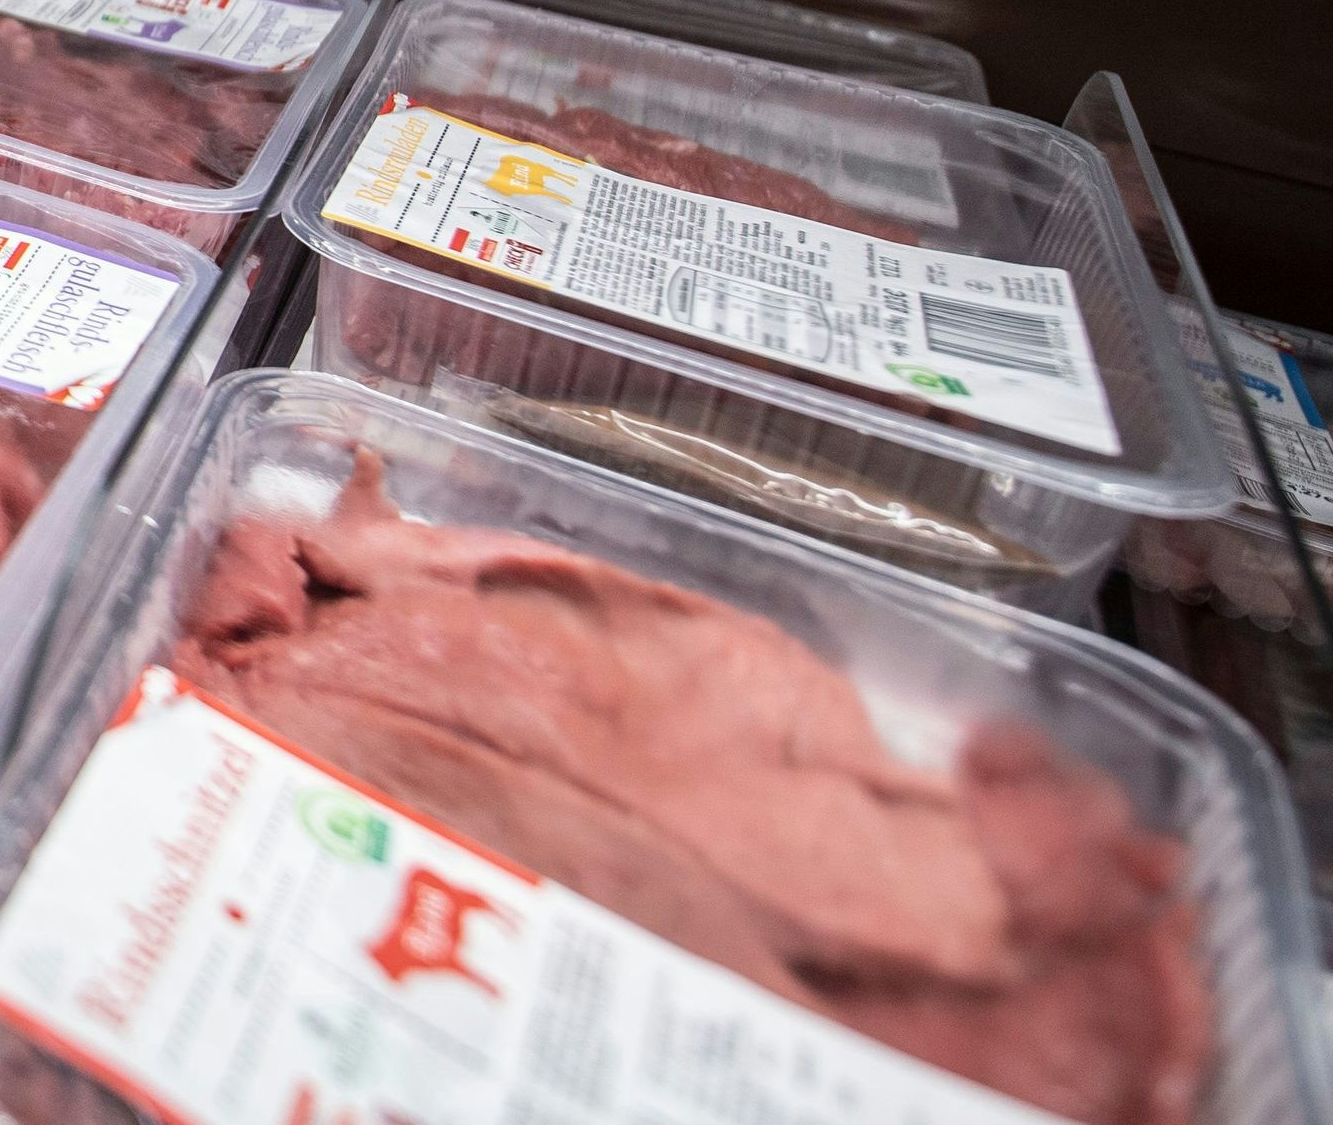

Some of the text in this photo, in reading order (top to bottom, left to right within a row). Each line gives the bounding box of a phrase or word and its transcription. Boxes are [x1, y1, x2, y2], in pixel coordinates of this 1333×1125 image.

[355, 117, 429, 206] Rindsrouladen
[503, 245, 525, 271] CHECK
[2, 256, 101, 373] gulaschfleisch
[69, 300, 131, 353] Rinds-
